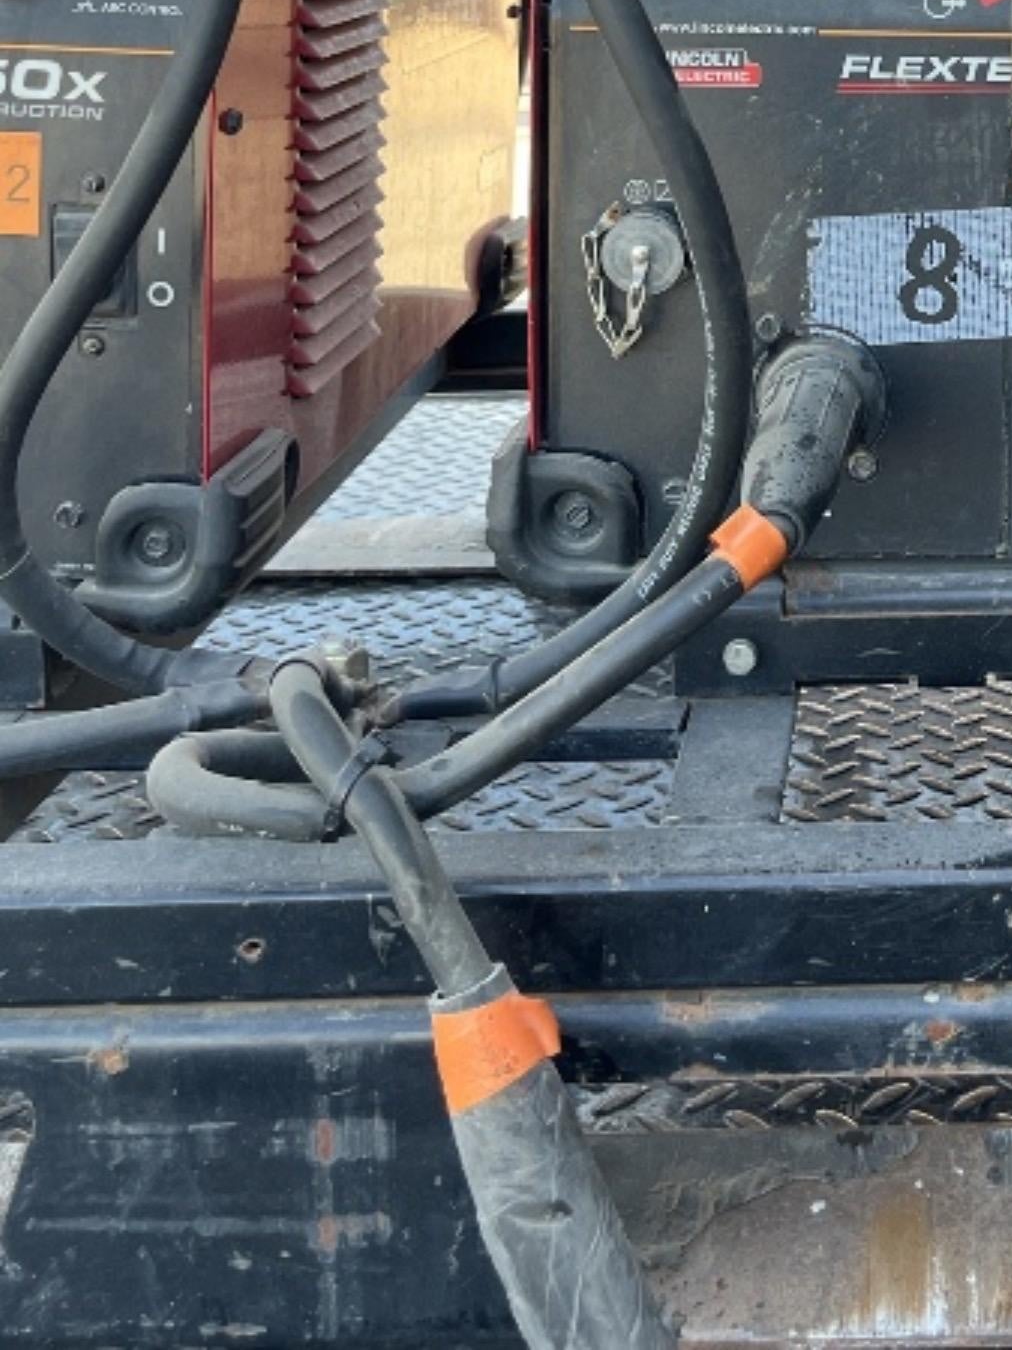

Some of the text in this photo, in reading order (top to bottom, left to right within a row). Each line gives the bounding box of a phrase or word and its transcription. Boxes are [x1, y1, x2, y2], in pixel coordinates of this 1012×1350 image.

[665, 50, 740, 67] INCOLN
[7, 164, 31, 202] 2
[899, 223, 962, 326] 8
